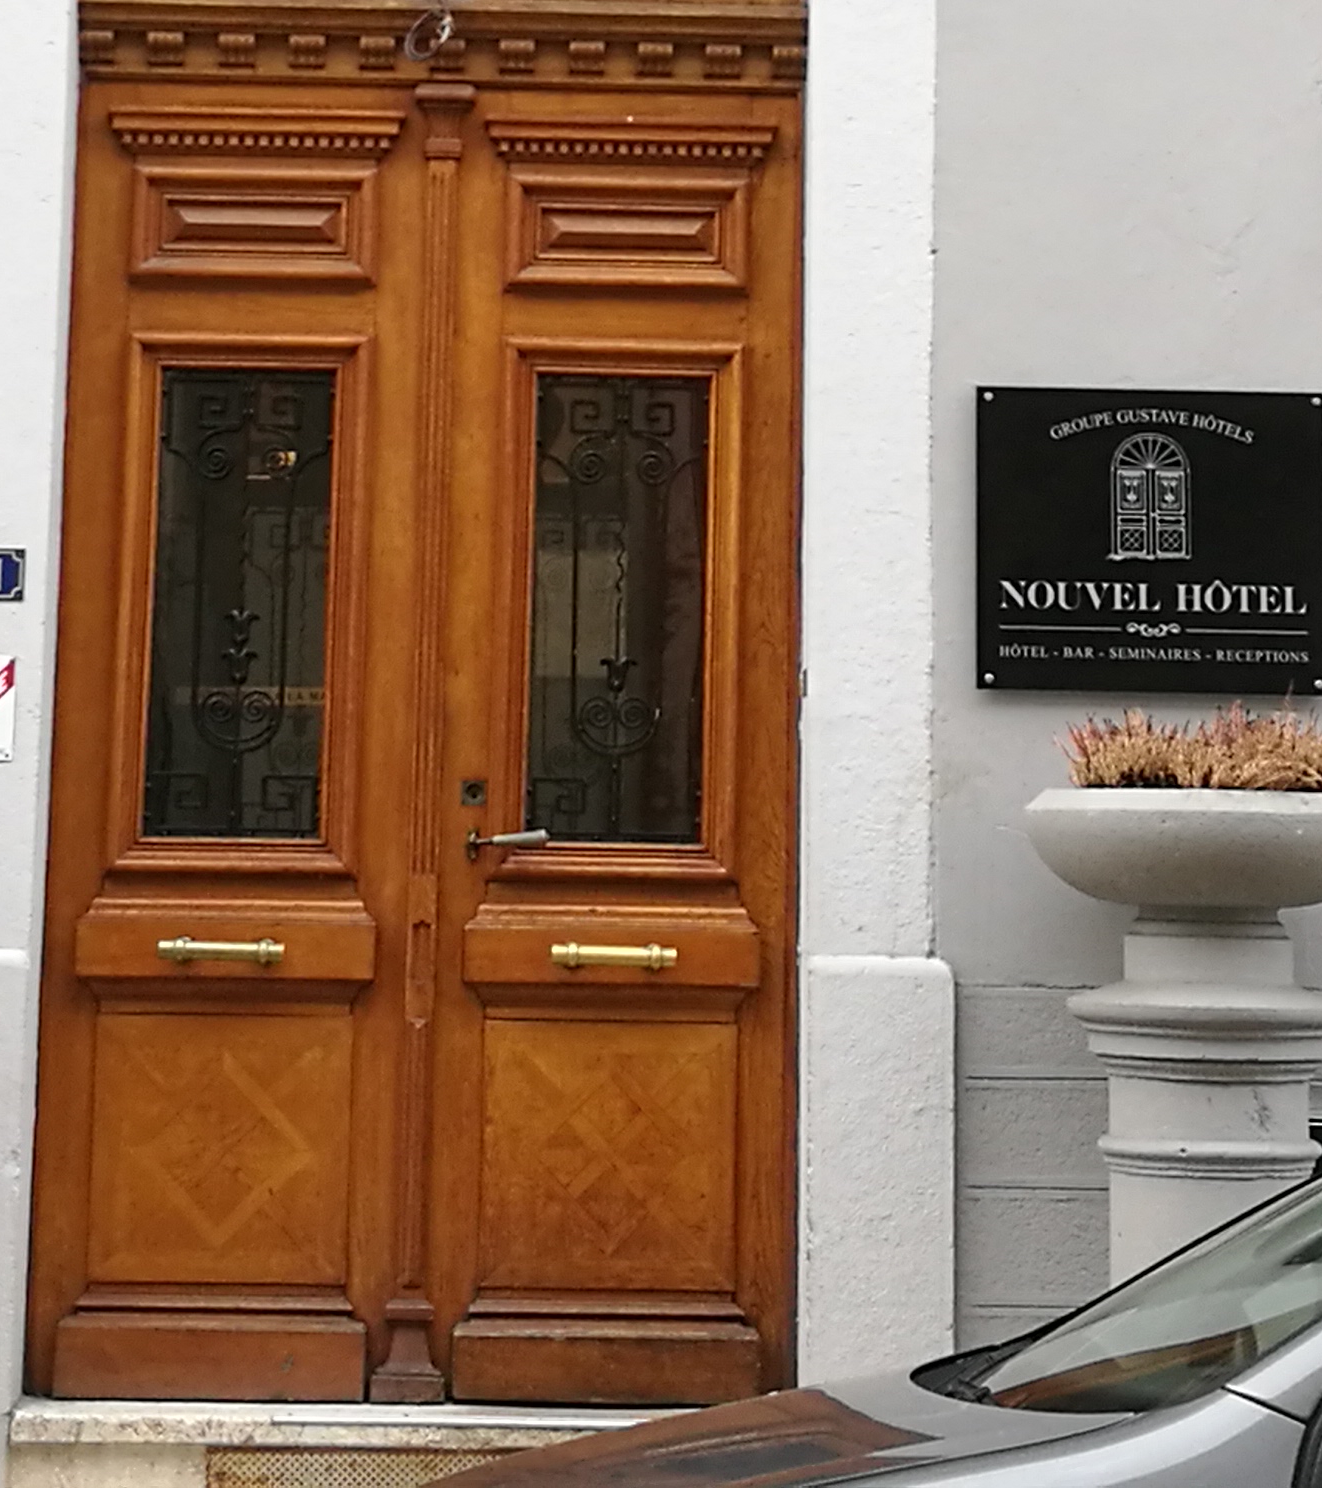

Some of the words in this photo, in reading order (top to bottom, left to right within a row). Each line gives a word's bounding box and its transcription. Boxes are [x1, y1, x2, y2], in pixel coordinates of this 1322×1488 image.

[1049, 411, 1114, 440] GROUPE
[1116, 408, 1189, 426] GUSTAVE
[1192, 413, 1254, 444] HÔTELS
[999, 580, 1161, 612] NOUVEL
[1176, 579, 1307, 615] HÔTEL
[999, 643, 1049, 658] HÔTEL
[1063, 646, 1094, 659] BAR
[1108, 647, 1202, 661] SEMINAIRES
[1216, 649, 1310, 663] RECEPTIONS
